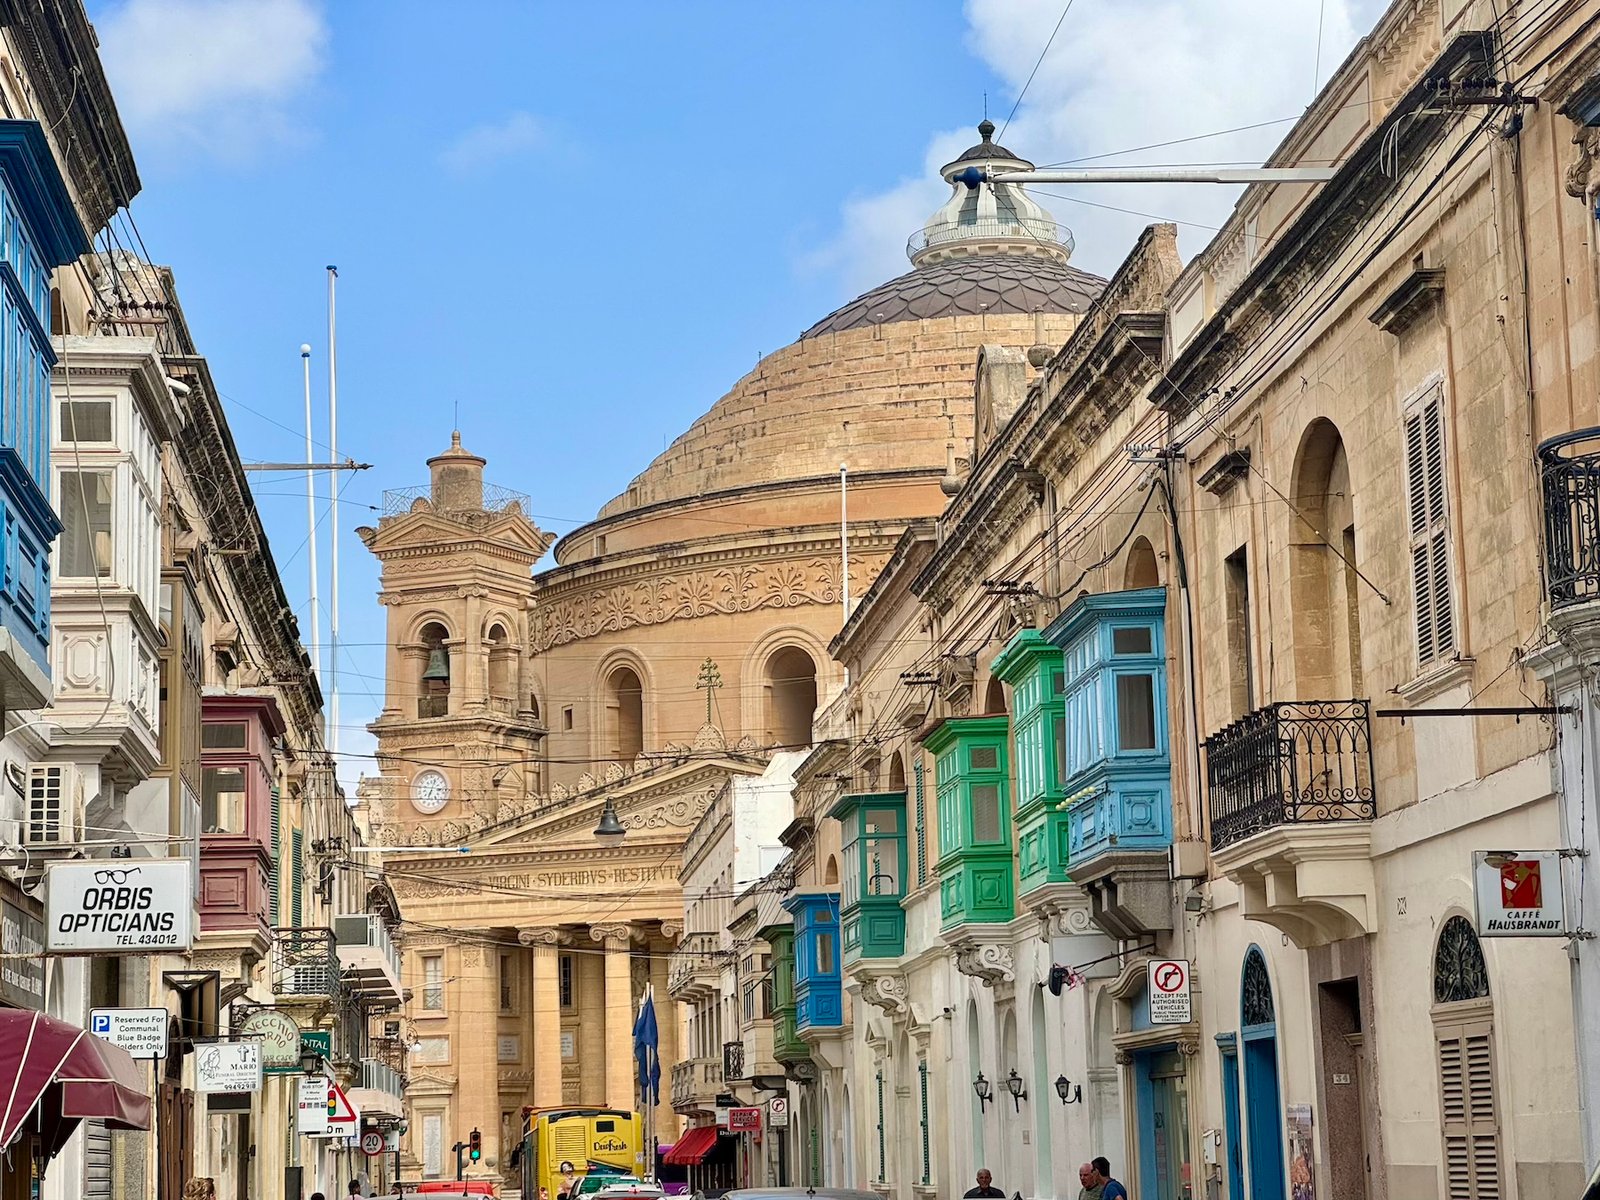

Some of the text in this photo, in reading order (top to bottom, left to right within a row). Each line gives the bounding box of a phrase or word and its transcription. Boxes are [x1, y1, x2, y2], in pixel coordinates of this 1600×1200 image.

[488, 874, 530, 889] VIRGINI
[537, 869, 607, 887] SYDERIBVS
[82, 887, 153, 911] ORBIS
[58, 912, 175, 933] OPTICIANS
[114, 1016, 150, 1024] Reserved
[119, 1025, 160, 1033] Communal
[117, 1034, 161, 1043] Blue Badge
[117, 1042, 164, 1052] olders Only
[230, 1063, 257, 1071] MARIO
[365, 1135, 379, 1147] 20
